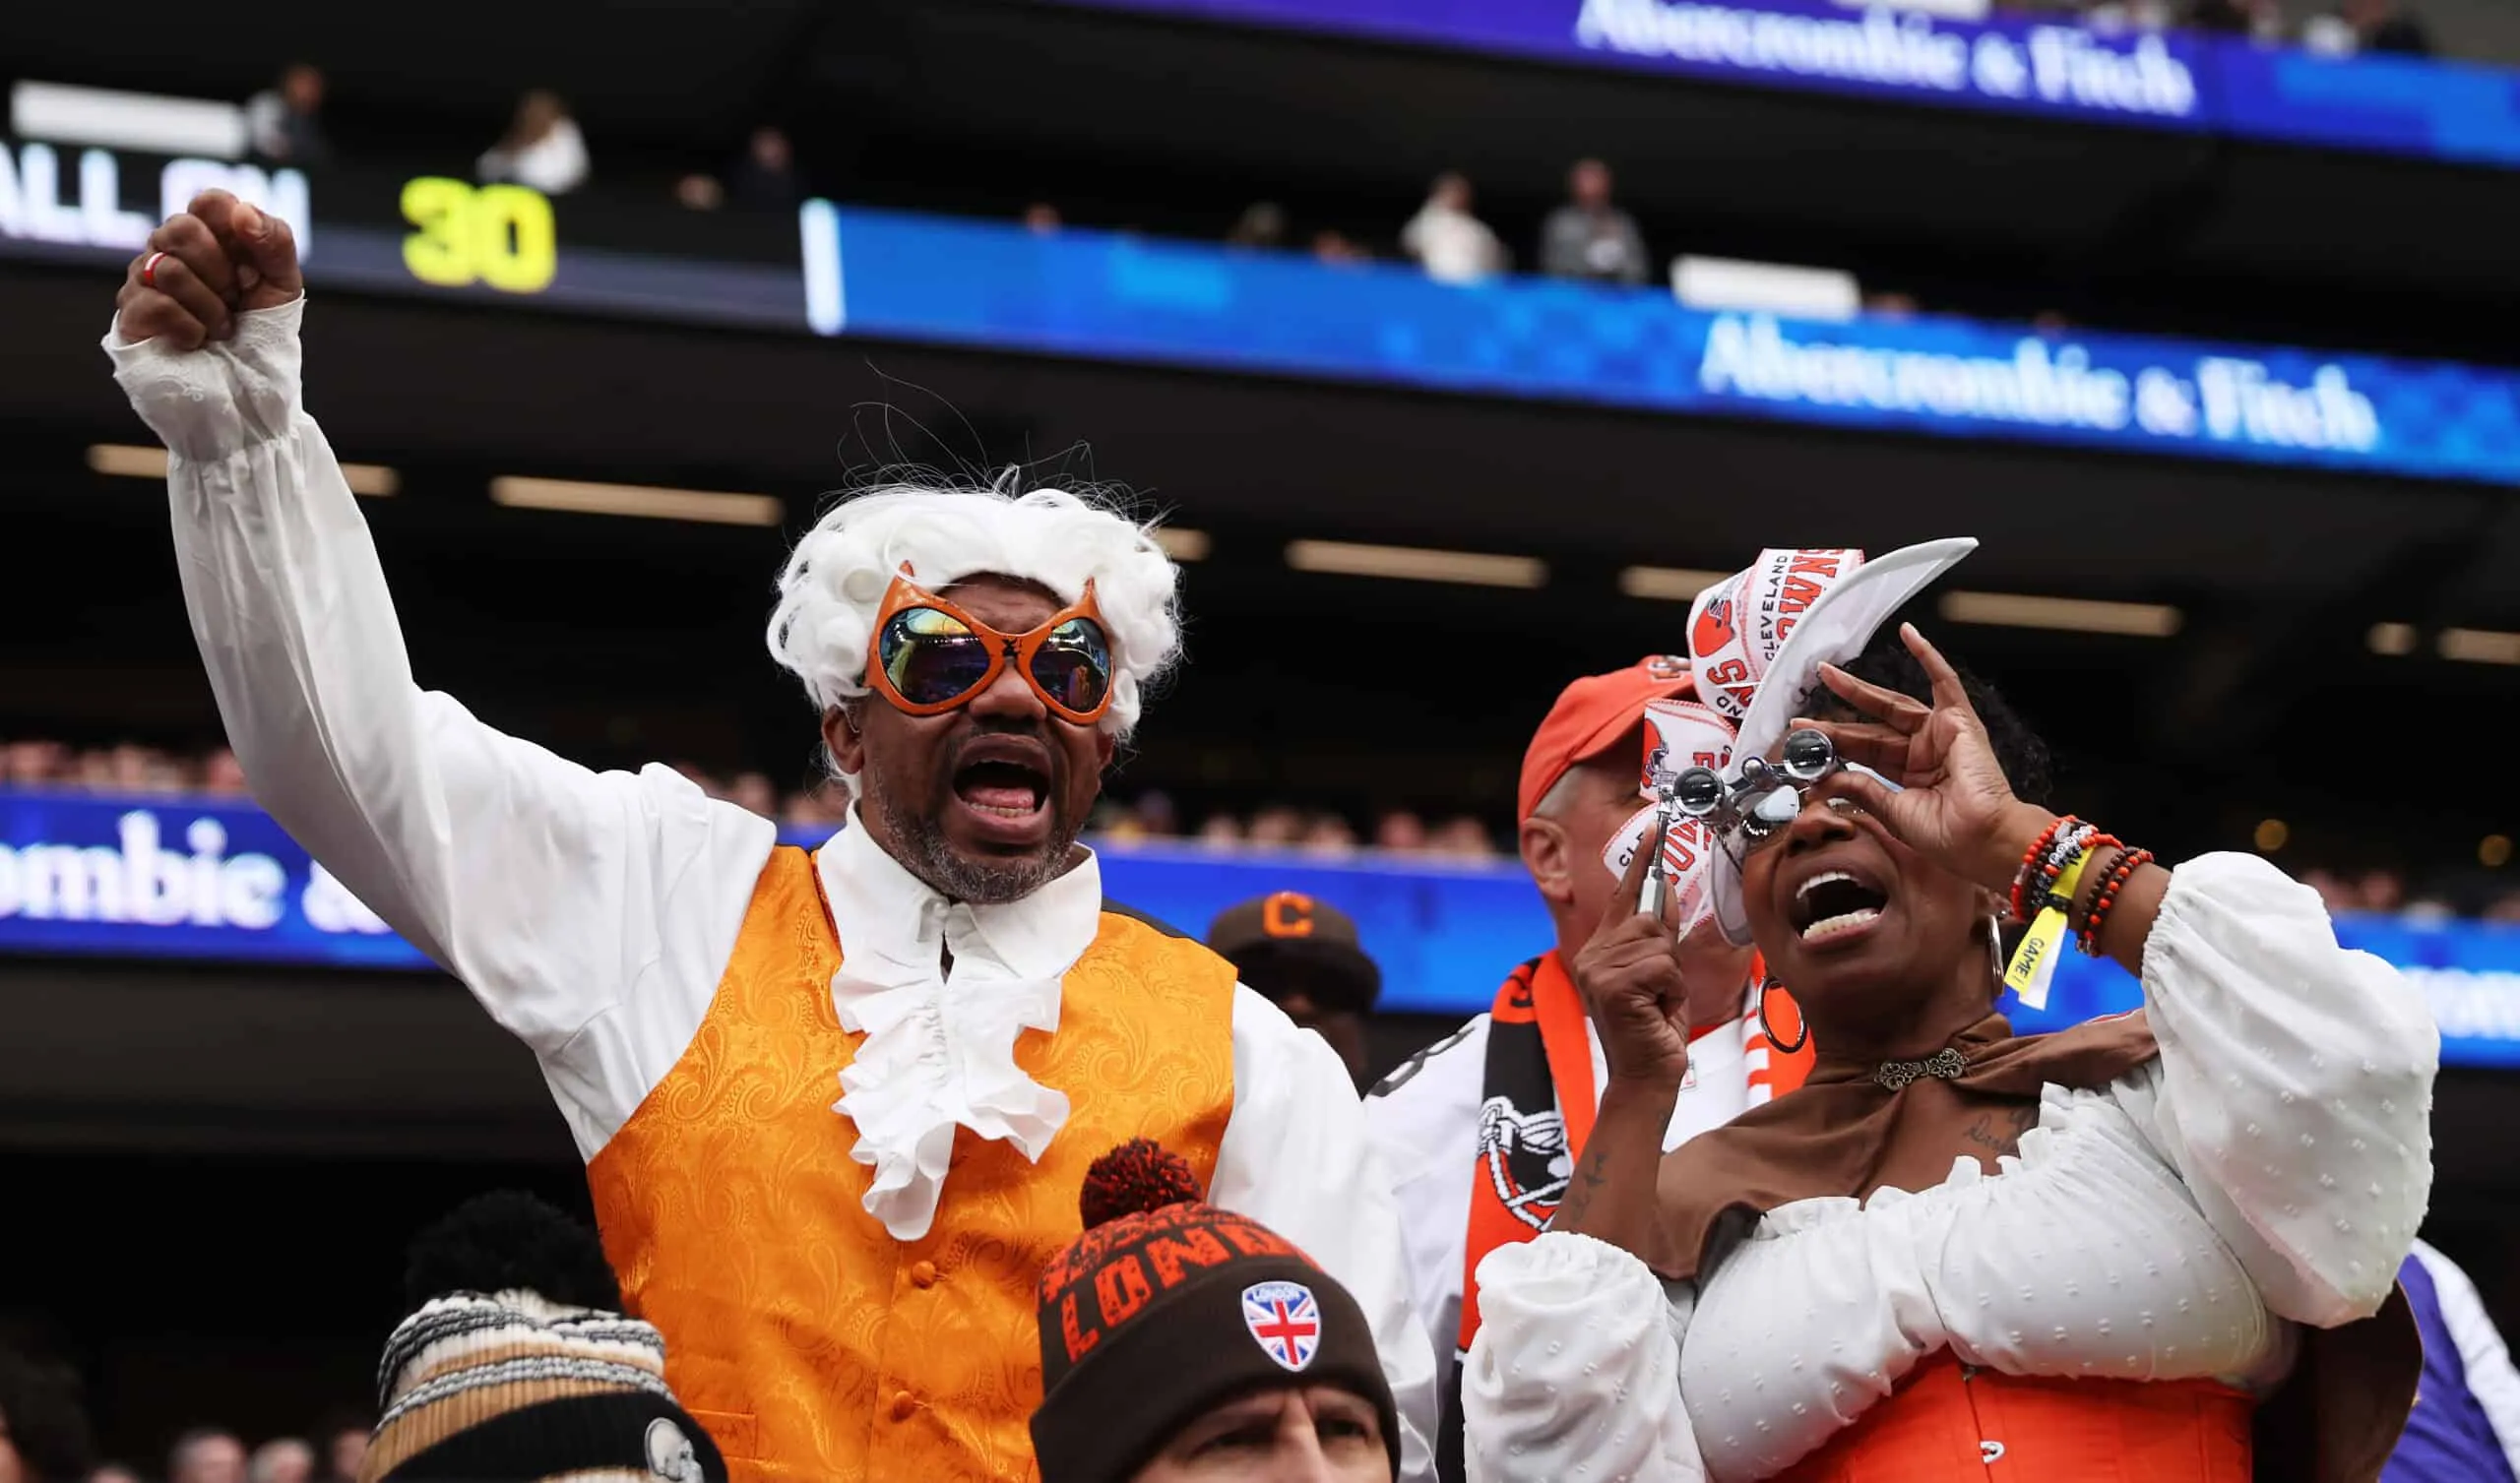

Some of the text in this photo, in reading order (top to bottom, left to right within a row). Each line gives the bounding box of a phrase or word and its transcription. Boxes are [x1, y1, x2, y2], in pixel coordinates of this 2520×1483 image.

[400, 175, 556, 293] 30
[1701, 315, 2129, 430] Abercrombie
[2198, 356, 2377, 453] Fitch
[1760, 555, 1789, 661] CLEVELAND
[0, 810, 286, 929] mbie
[1263, 891, 1314, 939] C
[1062, 1223, 1317, 1363] LOND
